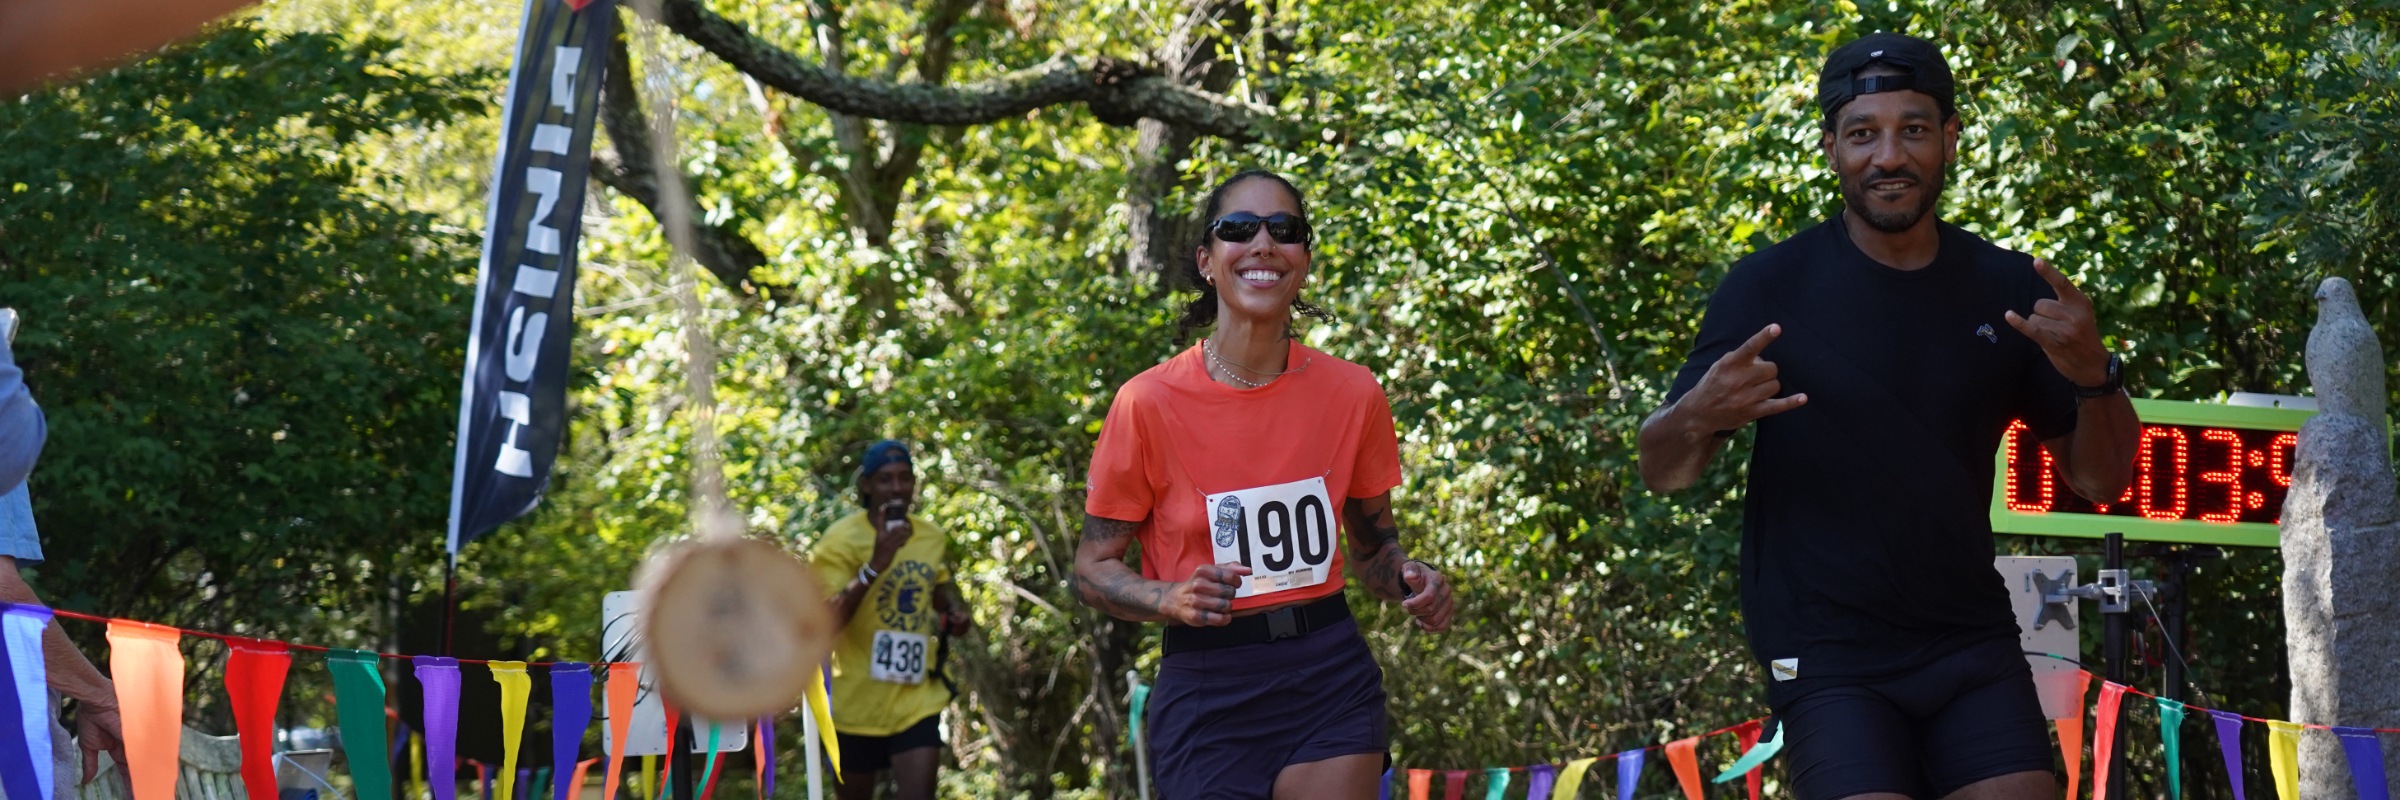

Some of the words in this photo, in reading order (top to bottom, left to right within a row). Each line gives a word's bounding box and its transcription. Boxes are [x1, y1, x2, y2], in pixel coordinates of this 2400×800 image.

[493, 45, 583, 480] FINISH
[1236, 493, 1330, 576] 190
[876, 636, 923, 674] 438
